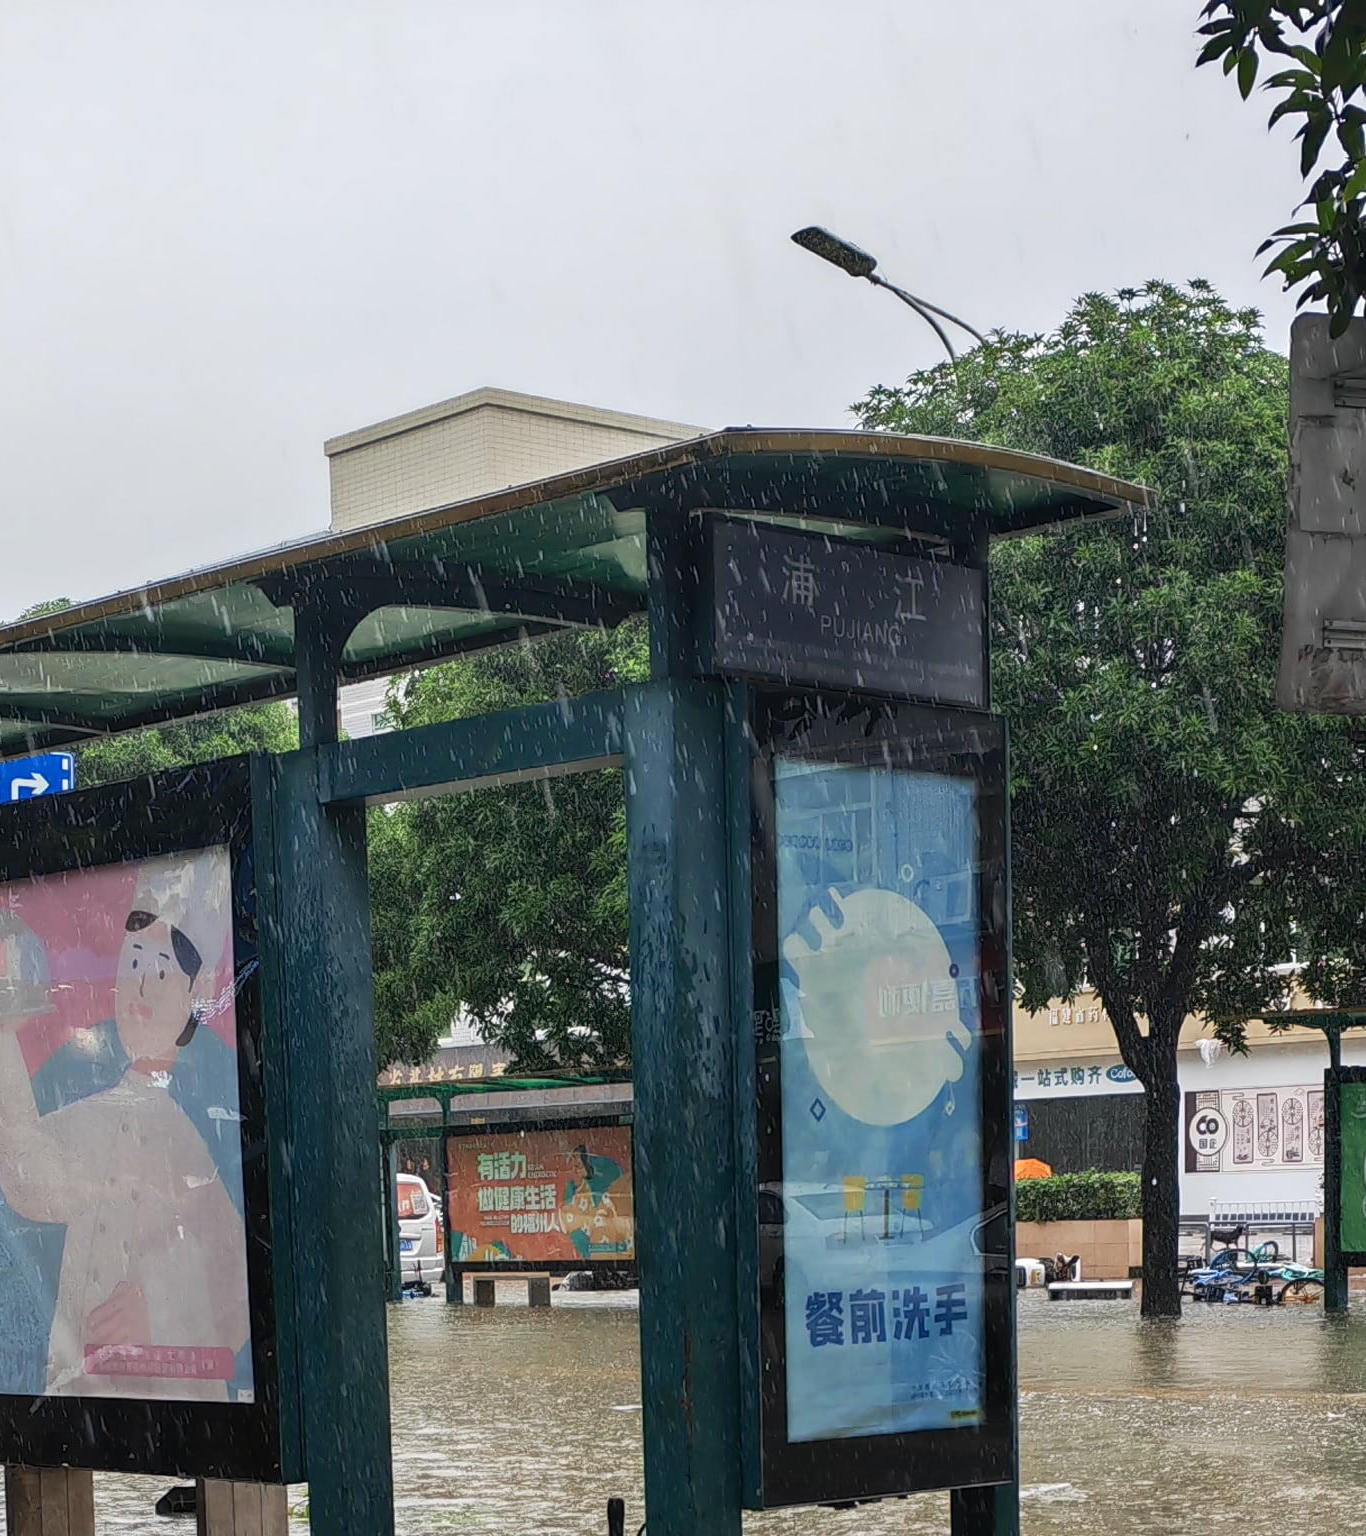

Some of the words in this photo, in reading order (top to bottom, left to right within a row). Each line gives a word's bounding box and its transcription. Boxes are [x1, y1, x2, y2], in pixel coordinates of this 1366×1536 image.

[820, 614, 902, 649] PUJIANG
[477, 1151, 527, 1181] 有活力
[477, 1183, 557, 1212] 做健康生活
[510, 1208, 568, 1235] 的福州人
[805, 1283, 968, 1348] 餐前洗手
